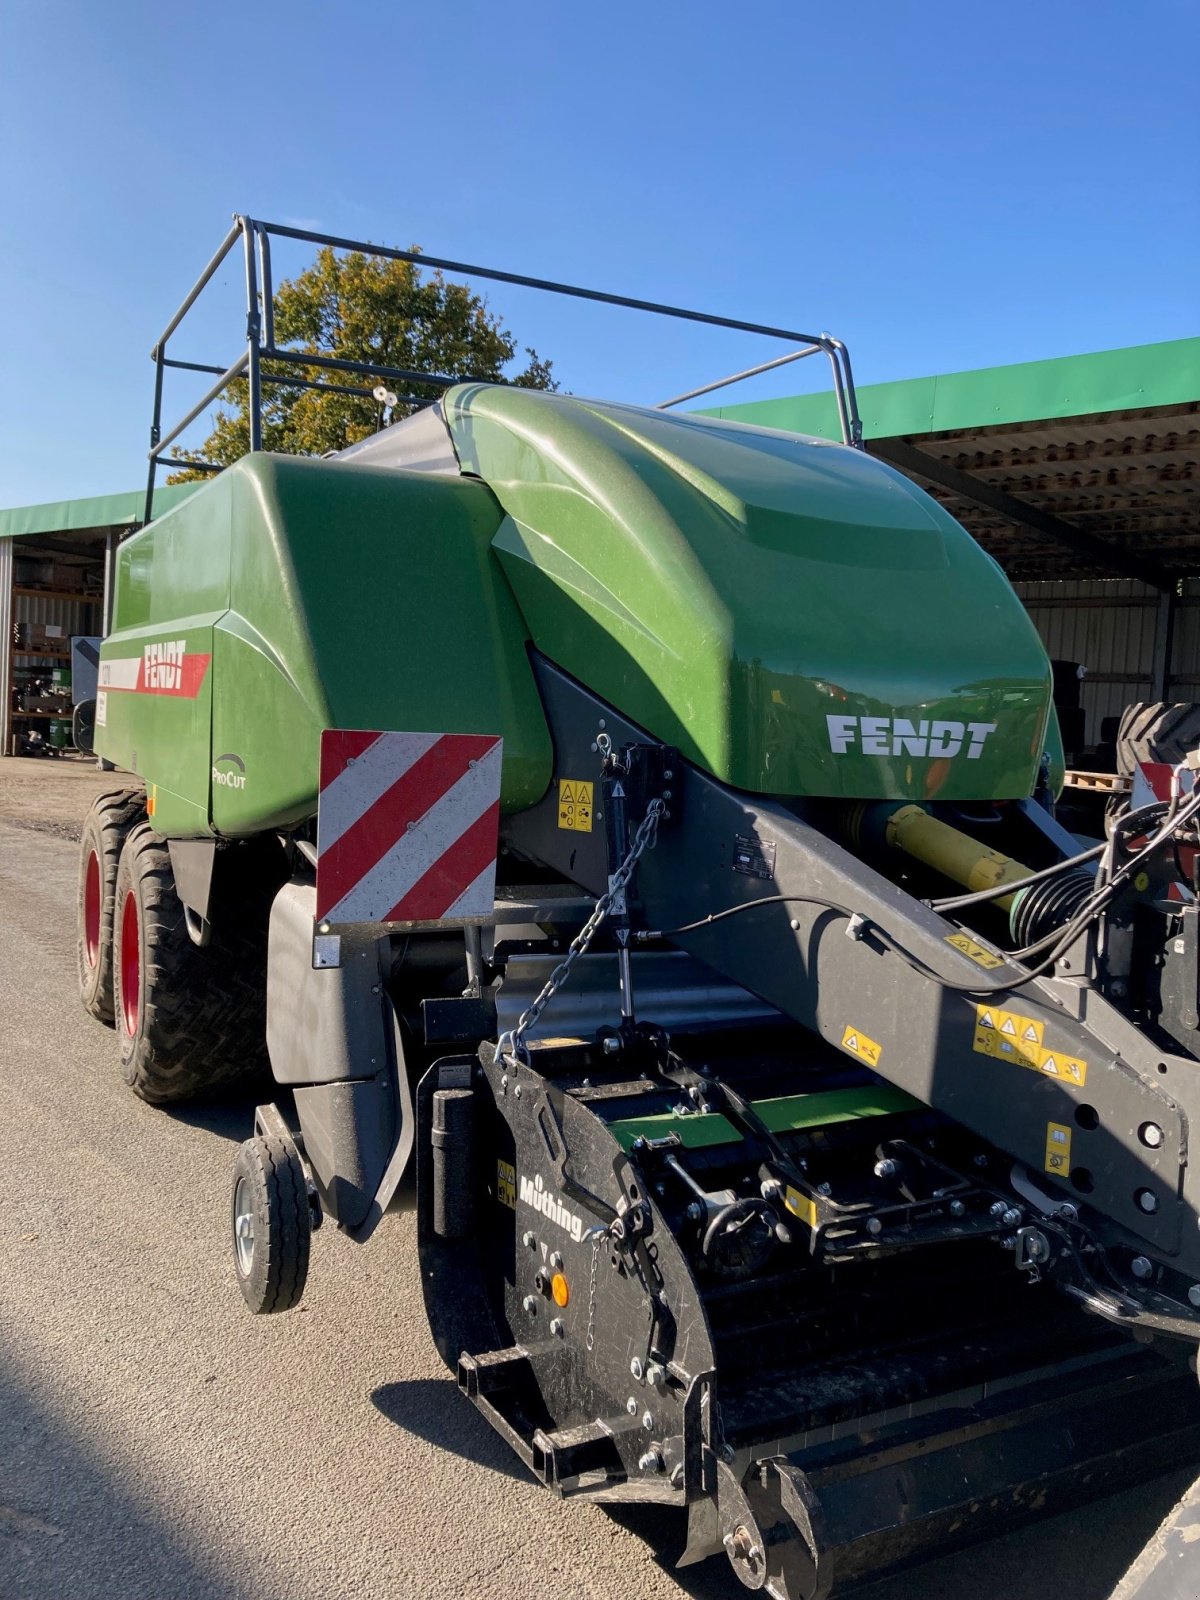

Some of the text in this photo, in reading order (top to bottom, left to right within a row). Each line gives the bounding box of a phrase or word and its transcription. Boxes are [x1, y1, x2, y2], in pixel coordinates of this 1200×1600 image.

[144, 640, 186, 690] FENDT
[826, 714, 998, 759] FENDT
[520, 1173, 583, 1243] Müthing
